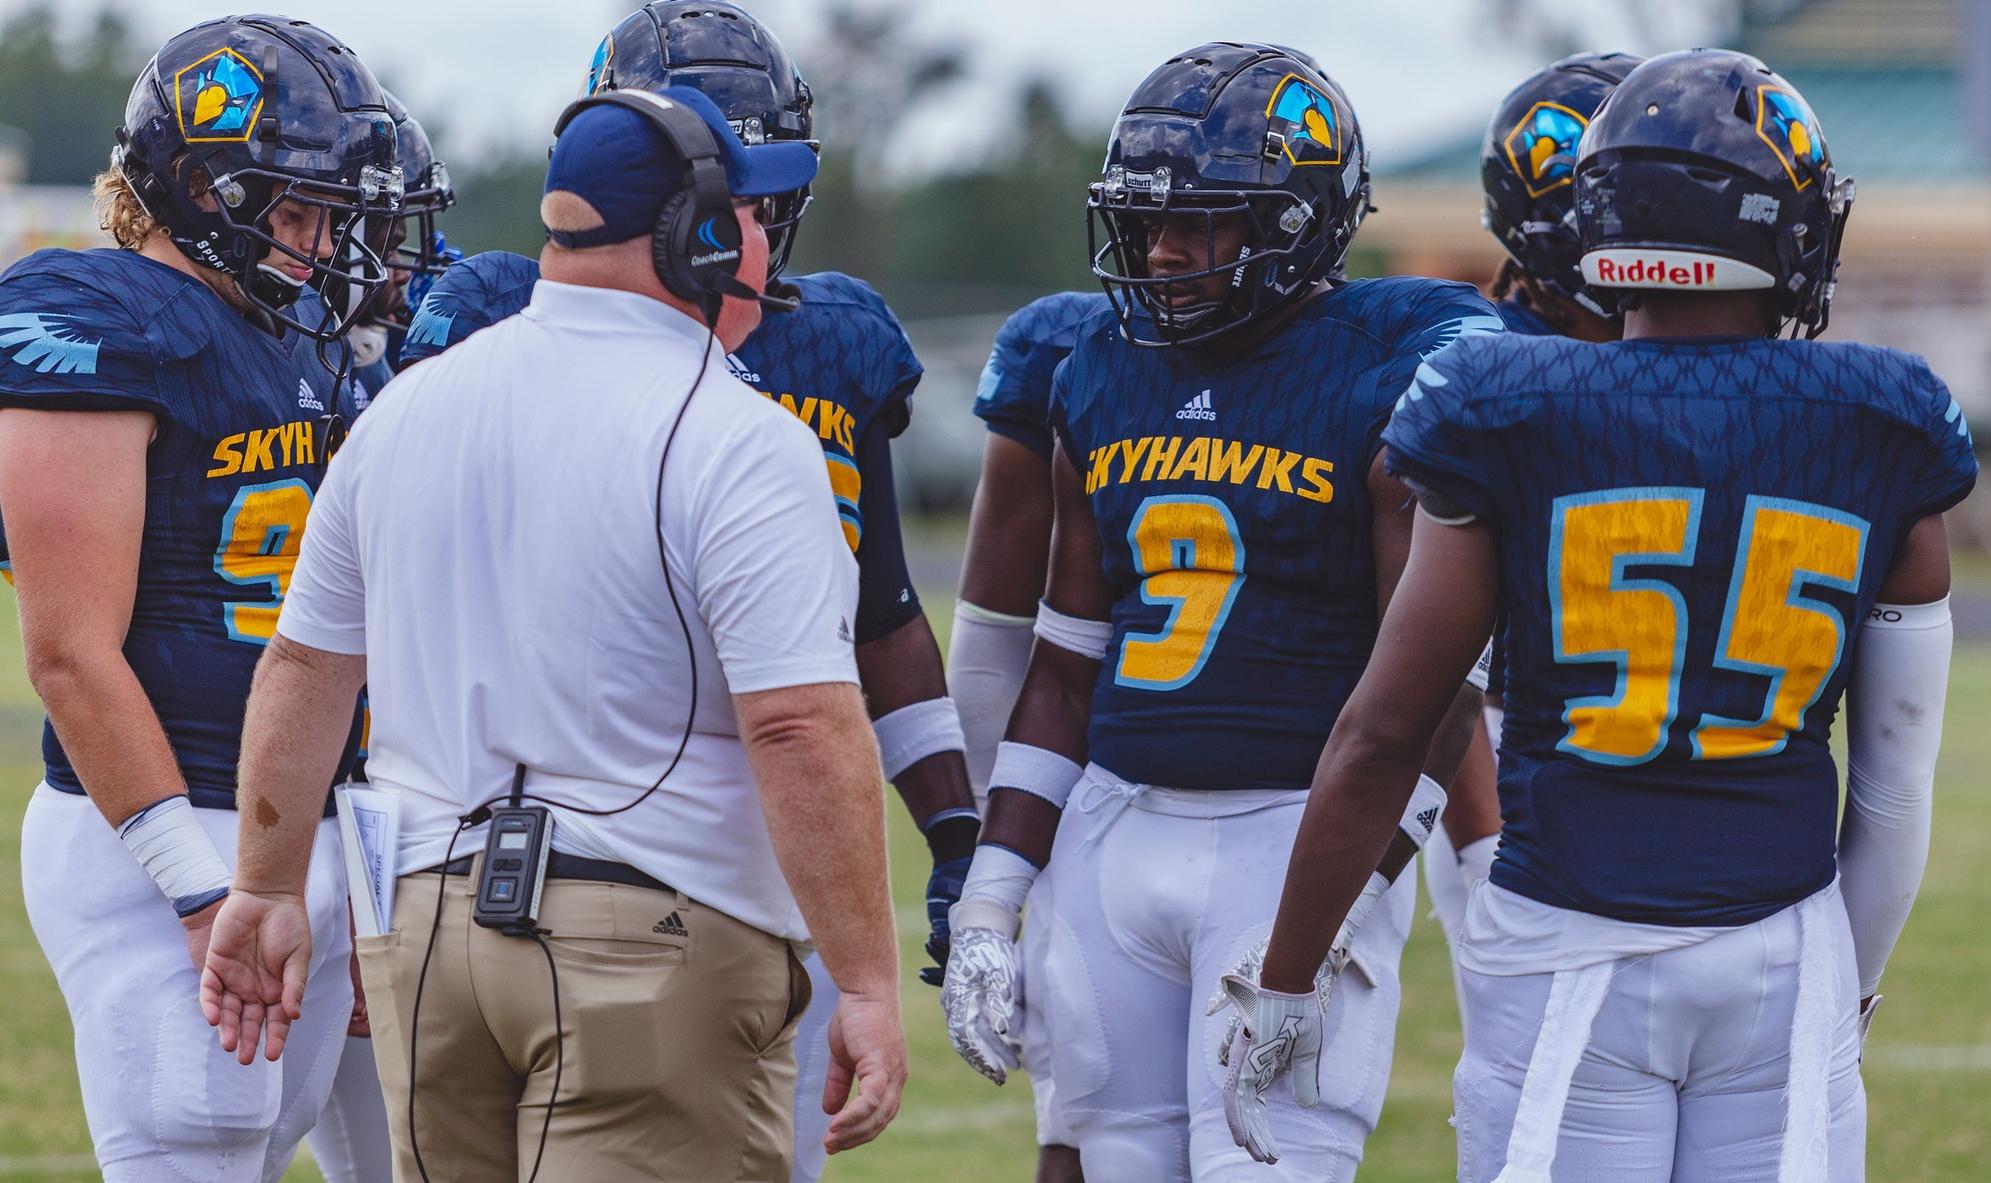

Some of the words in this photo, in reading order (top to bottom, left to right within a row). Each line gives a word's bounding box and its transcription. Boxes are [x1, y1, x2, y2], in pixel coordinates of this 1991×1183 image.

[691, 250, 739, 267] CoachComm
[1598, 258, 1715, 286] Riddell
[1175, 406, 1216, 421] adidas
[206, 421, 315, 479] SKYH
[1114, 494, 1248, 691] 9
[1547, 486, 1871, 766] 55
[652, 924, 689, 937] adidas
